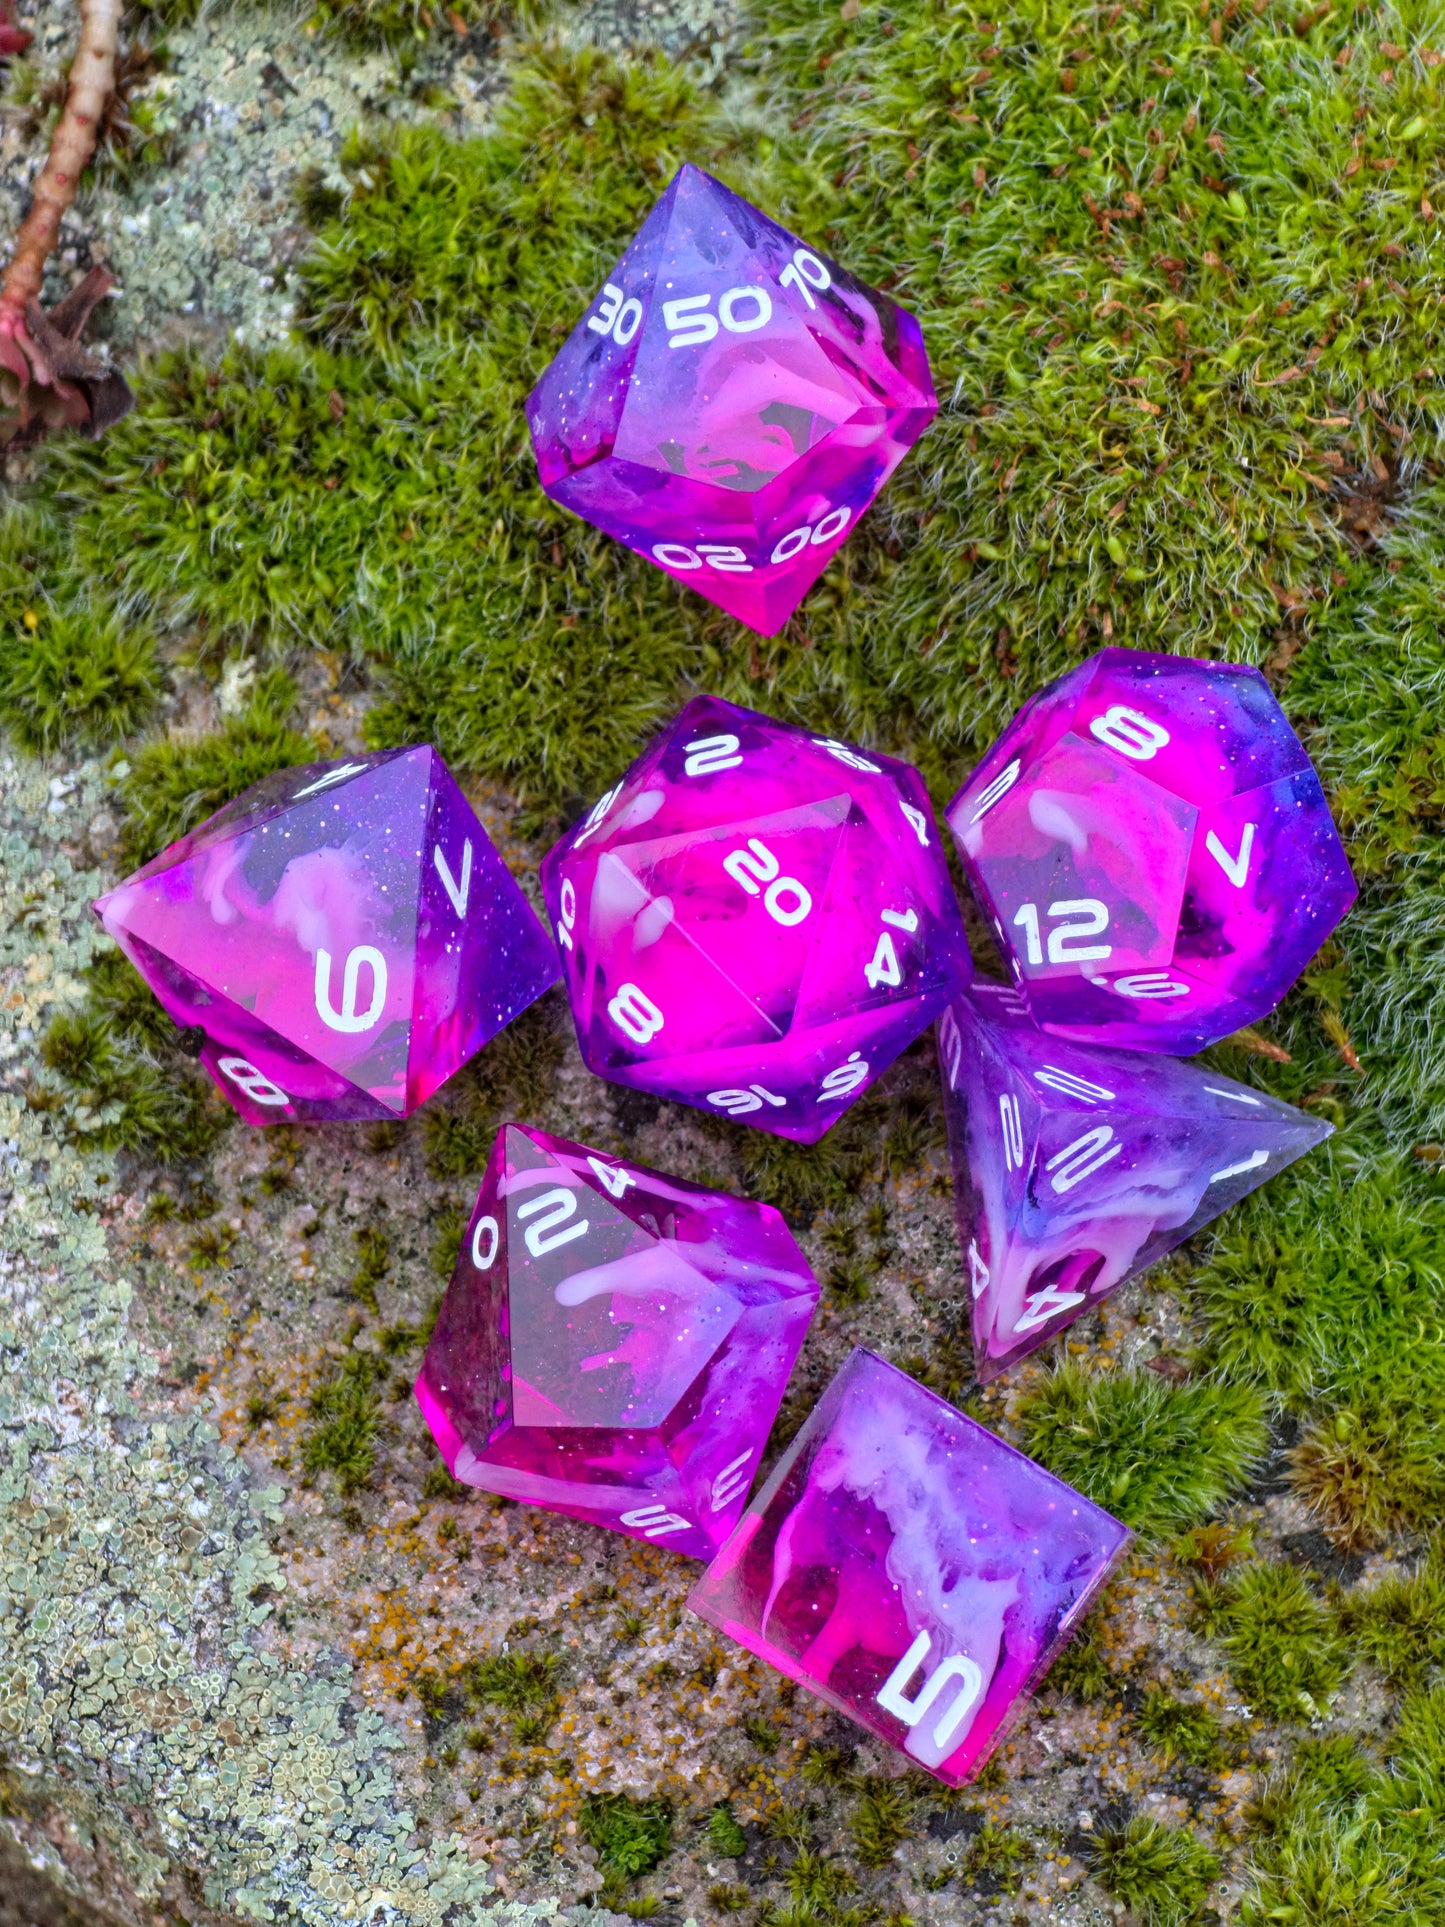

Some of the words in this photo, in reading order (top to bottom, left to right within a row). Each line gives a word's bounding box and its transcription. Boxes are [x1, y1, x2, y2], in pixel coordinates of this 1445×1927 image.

[780, 250, 831, 310] 10
[588, 284, 643, 345] 30
[663, 286, 773, 349] 50
[652, 544, 754, 572] 20
[771, 507, 851, 563] 00
[684, 734, 743, 776] 2
[1089, 706, 1170, 760] 8
[899, 801, 930, 846] 4
[723, 838, 812, 926] 20
[557, 878, 577, 951] 10
[1013, 898, 1112, 964] 12
[865, 908, 919, 989] 14
[608, 983, 664, 1044] 8
[218, 1057, 290, 1105] 8
[1033, 1064, 1116, 1104] 2
[1000, 1094, 1024, 1172] 2
[1045, 1125, 1123, 1194] 2
[588, 1156, 637, 1198] 4
[1209, 1150, 1270, 1184] 1
[472, 1215, 499, 1270] 0
[517, 1188, 590, 1257] 2
[1013, 1283, 1086, 1333] 4
[619, 1504, 693, 1538] 5
[876, 1629, 982, 1749] 5
